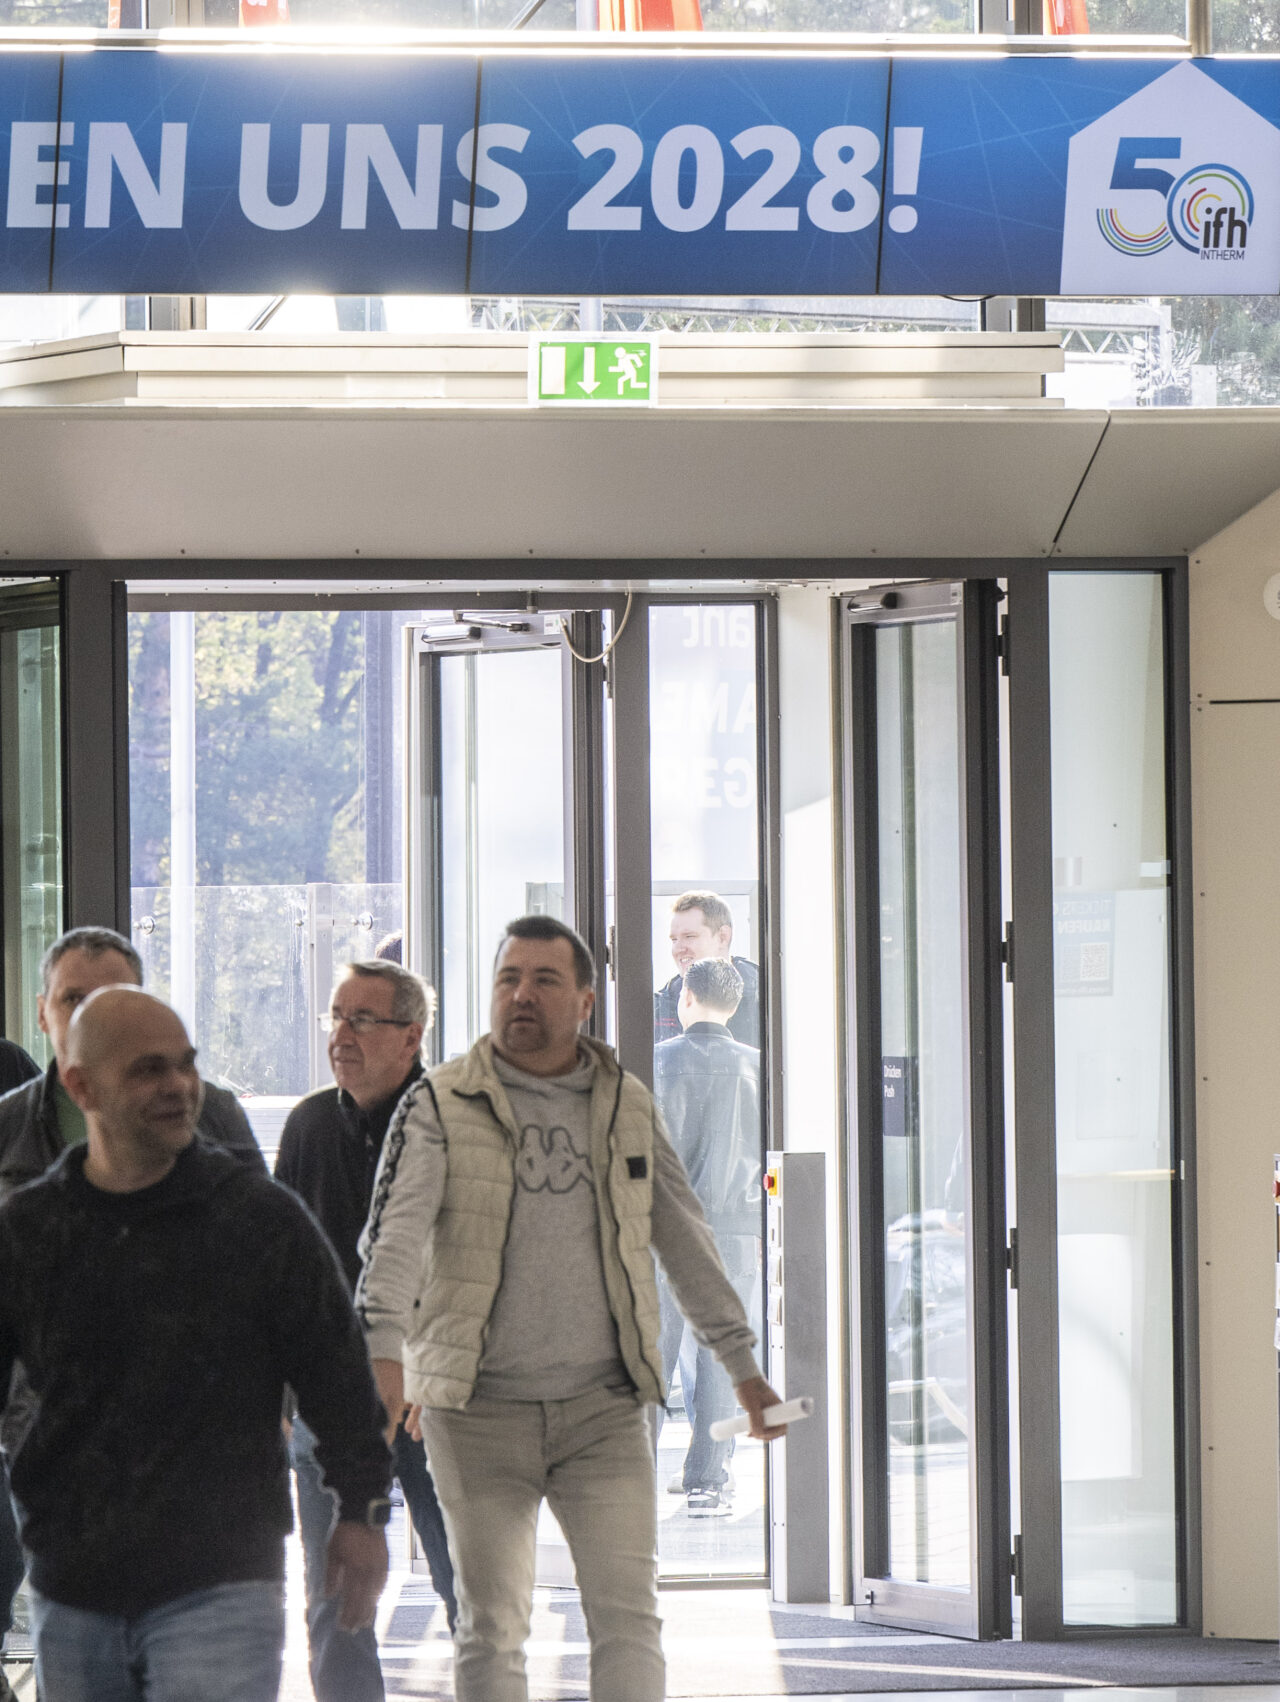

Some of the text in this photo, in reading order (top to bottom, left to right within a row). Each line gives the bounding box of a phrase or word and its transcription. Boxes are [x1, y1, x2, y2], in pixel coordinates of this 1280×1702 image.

[238, 122, 532, 232] UNS
[567, 123, 924, 233] 2028!
[1202, 207, 1247, 249] ifh
[1200, 249, 1246, 261] INTHERM
